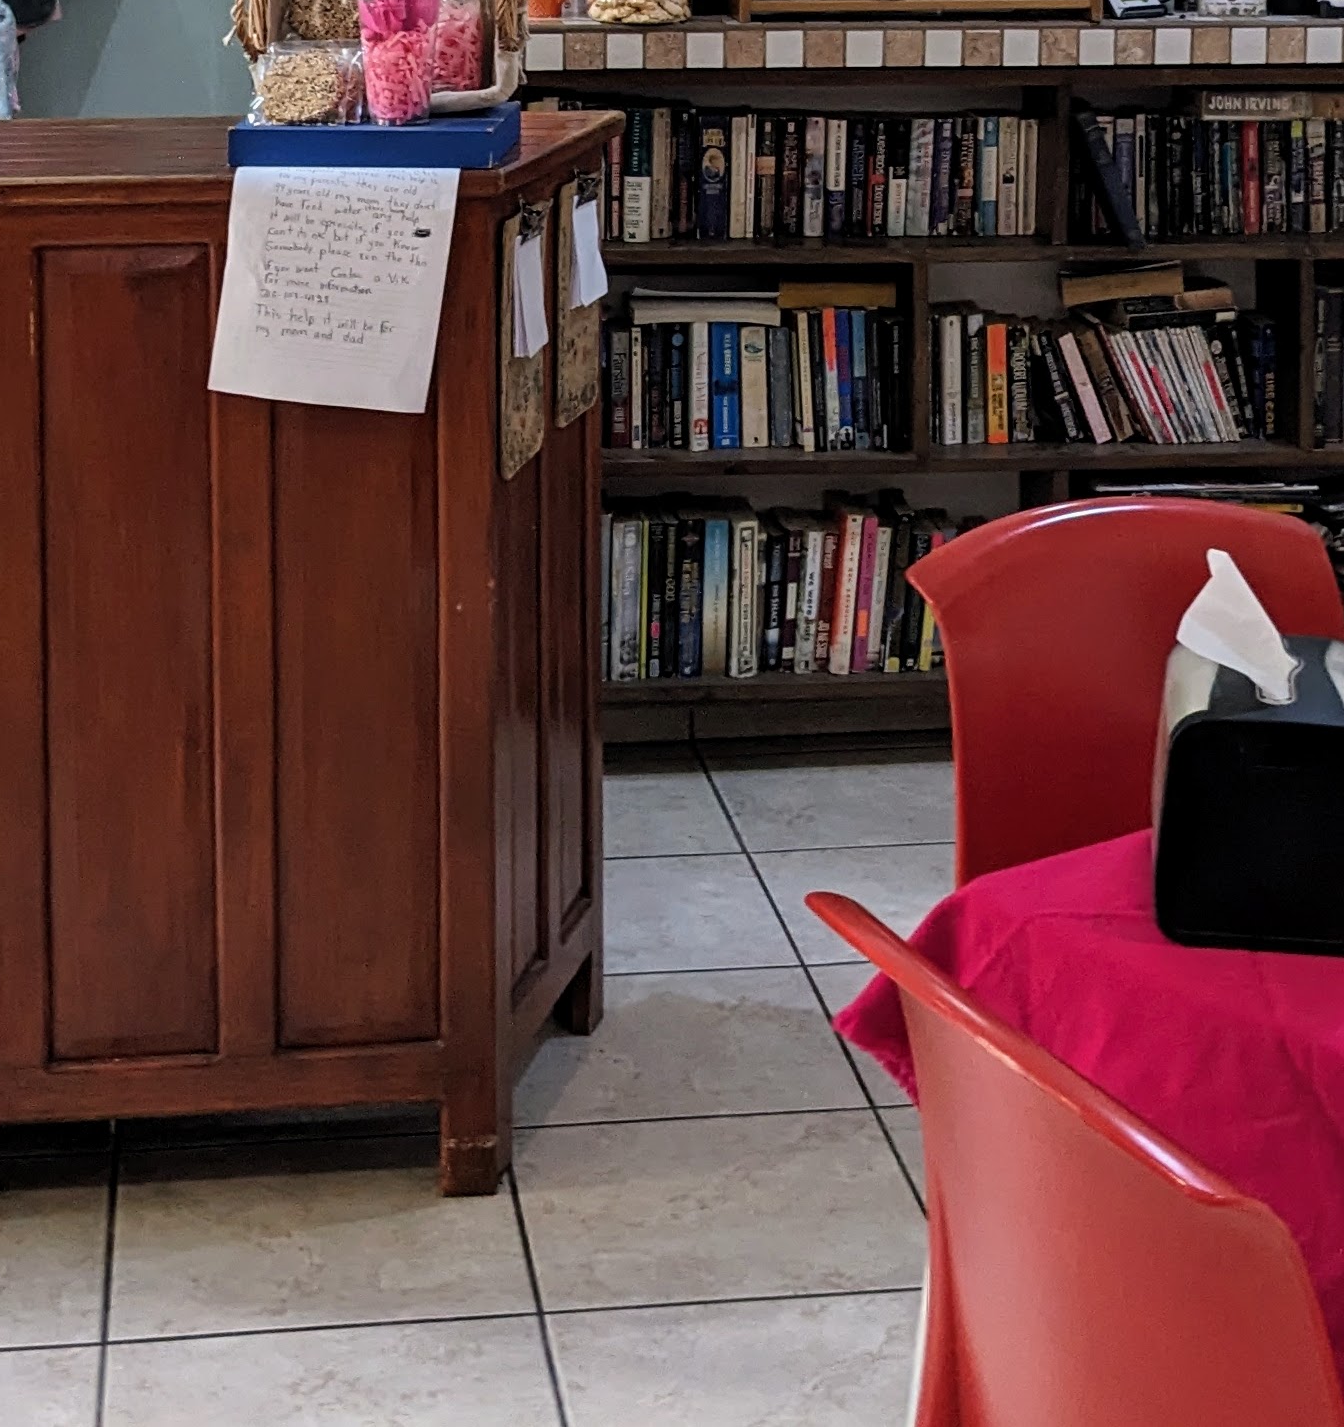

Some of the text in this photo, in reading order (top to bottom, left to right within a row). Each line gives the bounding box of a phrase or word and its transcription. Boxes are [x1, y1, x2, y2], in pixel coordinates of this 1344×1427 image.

[1208, 96, 1290, 112] JOHN IRVING
[333, 229, 349, 242] but
[368, 239, 385, 252] you
[257, 303, 282, 320] This
[289, 308, 315, 327] help
[281, 328, 308, 338] mom
[314, 329, 333, 340] and
[343, 333, 364, 345] dad
